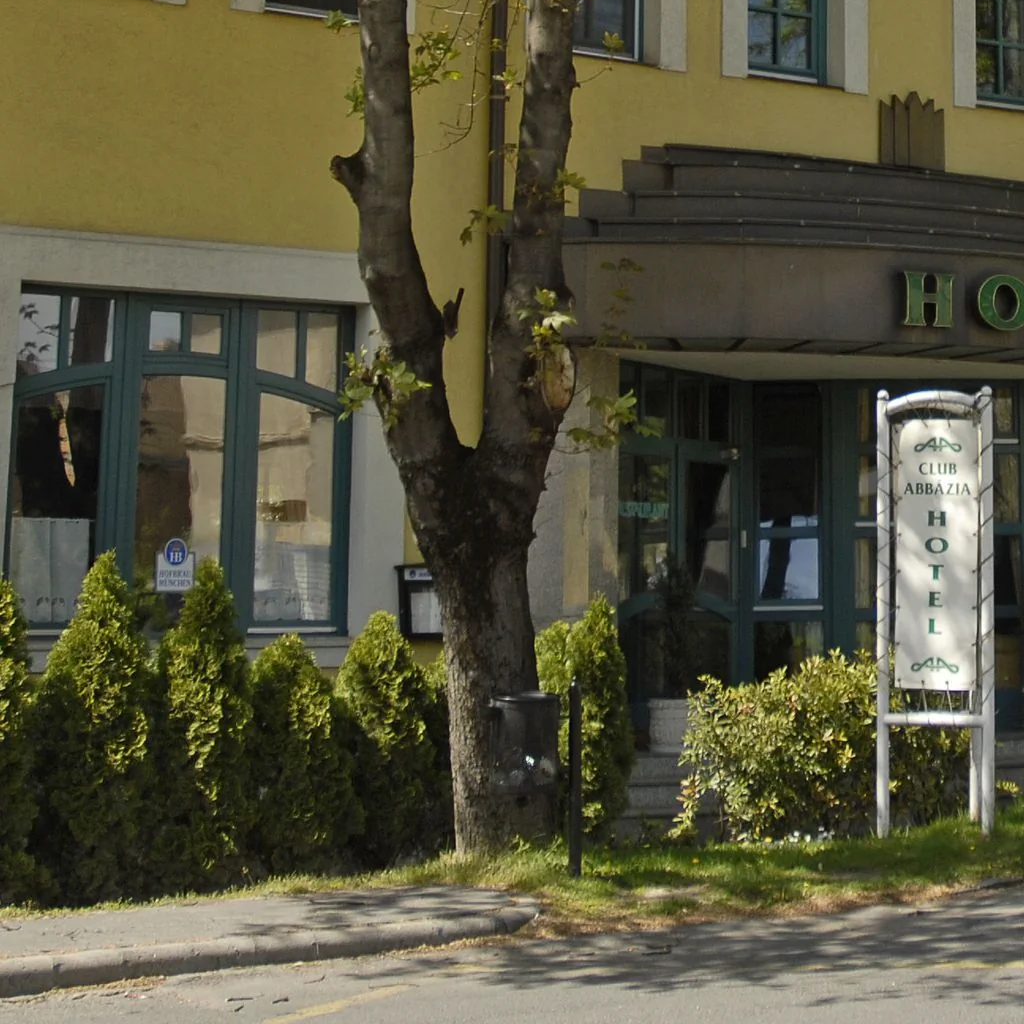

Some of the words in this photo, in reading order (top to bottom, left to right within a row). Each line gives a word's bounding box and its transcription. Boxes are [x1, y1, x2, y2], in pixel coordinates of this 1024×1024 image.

[918, 462, 957, 475] CLUB
[903, 478, 971, 495] ABBÁZIA
[924, 510, 949, 635] HOTEL
